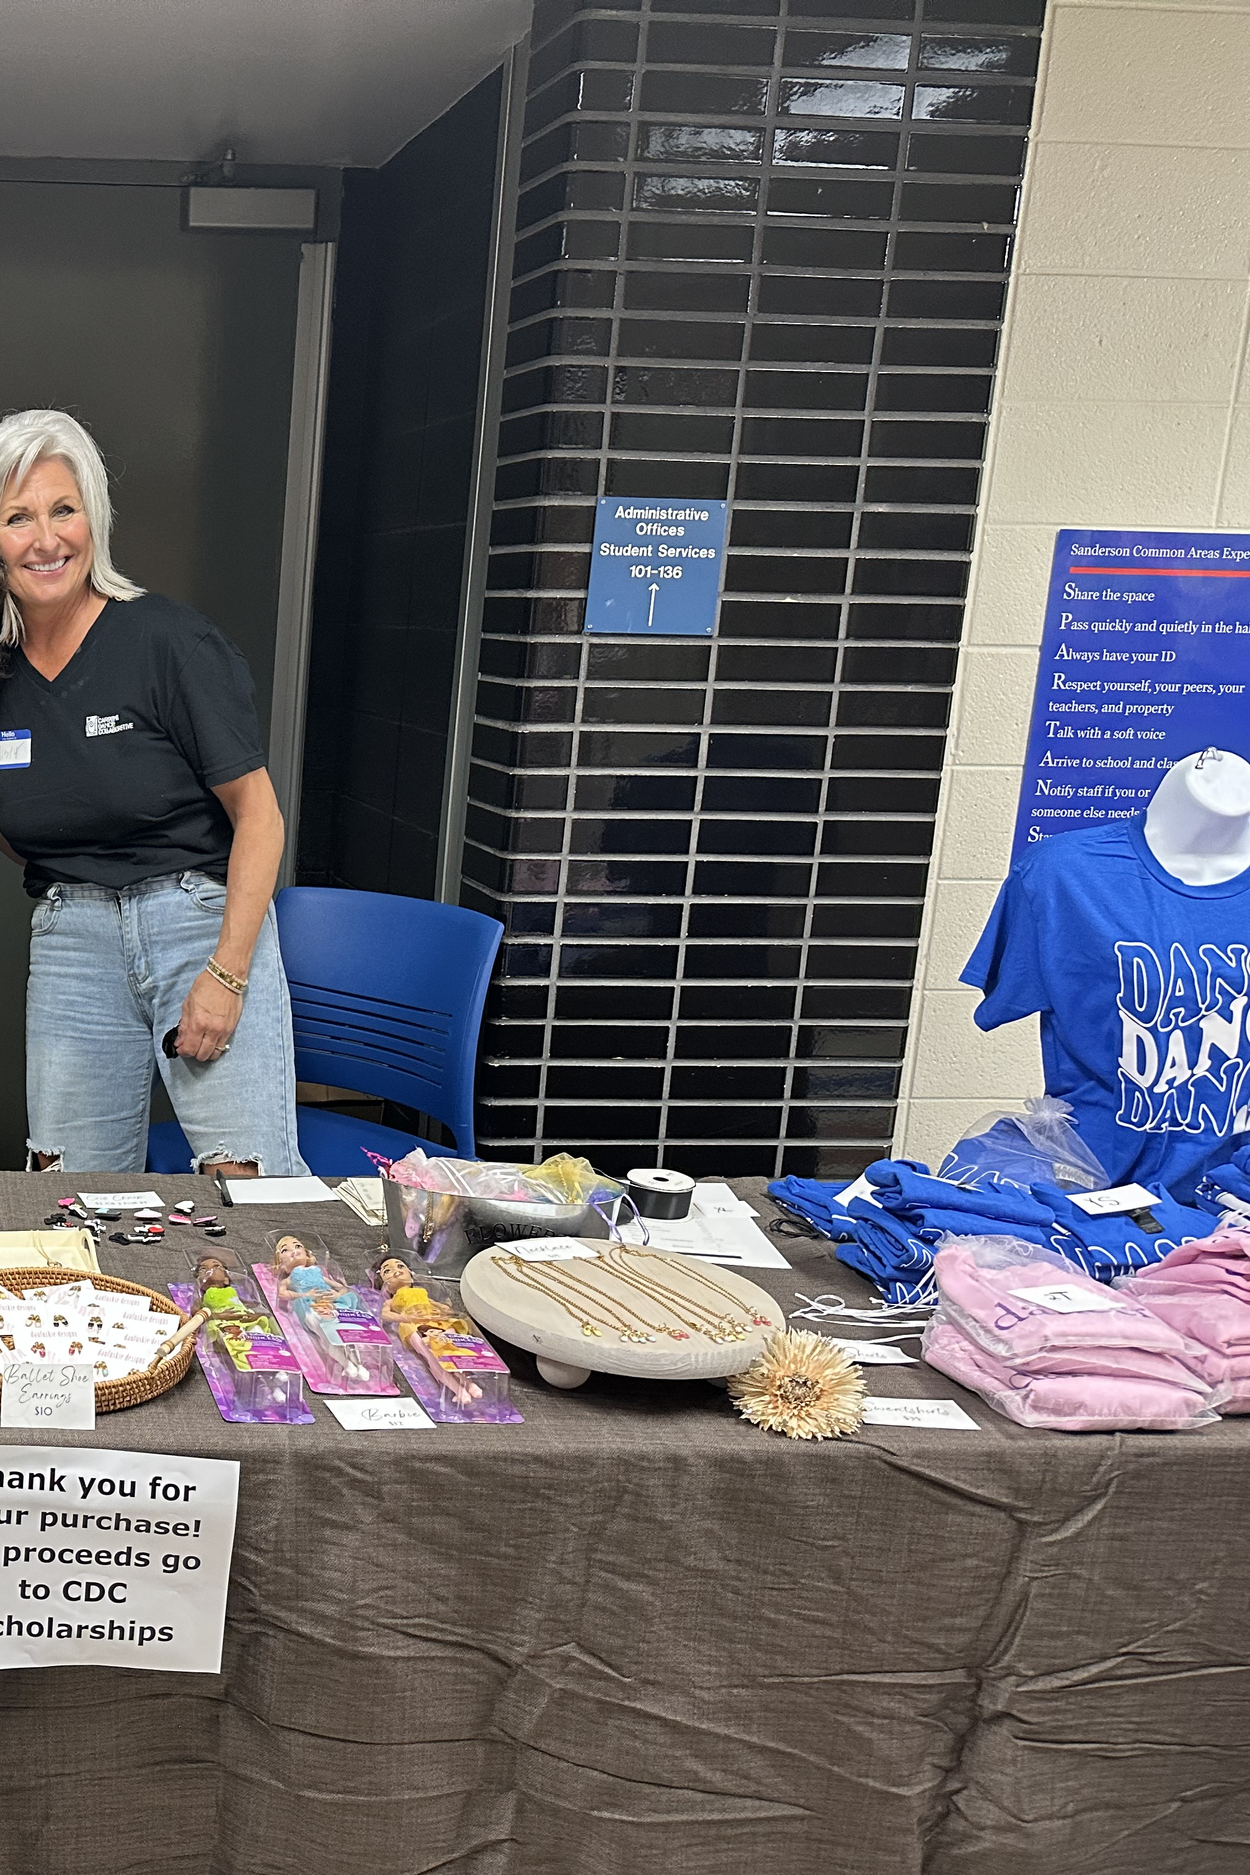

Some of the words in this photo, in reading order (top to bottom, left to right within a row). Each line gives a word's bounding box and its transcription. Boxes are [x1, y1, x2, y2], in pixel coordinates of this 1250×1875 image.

[614, 506, 709, 521] Administrative
[635, 523, 685, 536] Offices
[599, 543, 653, 557] Student
[657, 544, 716, 558] Services
[1070, 544, 1130, 557] Sanderson
[1132, 545, 1185, 559] Common
[1187, 547, 1220, 559] Areas
[629, 565, 683, 579] 101-136
[1063, 582, 1099, 601] Share
[1101, 589, 1120, 601] the
[1122, 590, 1155, 603] space
[1059, 613, 1089, 631] Pass
[1091, 618, 1132, 634] quickly
[1134, 620, 1156, 632] and
[1159, 621, 1199, 635] quietly
[1201, 621, 1212, 633] in
[1214, 620, 1233, 633] the
[1054, 642, 1100, 663] Always
[1102, 650, 1129, 662] have
[1130, 653, 1159, 664] your
[1161, 651, 1176, 662] ID
[1051, 673, 1102, 692] Respect
[1103, 680, 1152, 694] yourself,
[1154, 682, 1180, 695] your
[1182, 682, 1217, 695] peers,
[1218, 683, 1245, 696] your
[1048, 701, 1099, 714] teachers,
[1101, 702, 1123, 714] and
[1125, 703, 1174, 716] property
[1045, 721, 1075, 739] Talk
[1076, 726, 1101, 739] with
[1103, 730, 1111, 739] a
[1113, 727, 1135, 740] soft
[1136, 729, 1166, 741] voice
[1039, 750, 1080, 768] Arrive
[1082, 757, 1093, 768] to
[1095, 756, 1131, 769] school
[1133, 757, 1155, 769] and
[1035, 779, 1076, 799] Notify
[1077, 785, 1103, 797] staff
[1104, 786, 1115, 797] if
[1114, 789, 1135, 800] you
[1137, 789, 1151, 798] or
[1031, 807, 1081, 818] someone
[1083, 807, 1105, 818] else
[1114, 941, 1250, 1032] DAN
[1118, 995, 1250, 1093] DAN
[3, 1363, 55, 1385] Ballet
[59, 1365, 89, 1387] Shoe
[18, 1382, 72, 1409] Earrings
[34, 1406, 53, 1416] $10
[361, 1408, 421, 1421] Barbie
[78, 1475, 137, 1499] you
[149, 1476, 197, 1502] for
[39, 1510, 202, 1538] purchase!
[2, 1544, 151, 1568] proceeds
[162, 1552, 202, 1574] go
[18, 1579, 50, 1600] to
[62, 1580, 128, 1604] CDC
